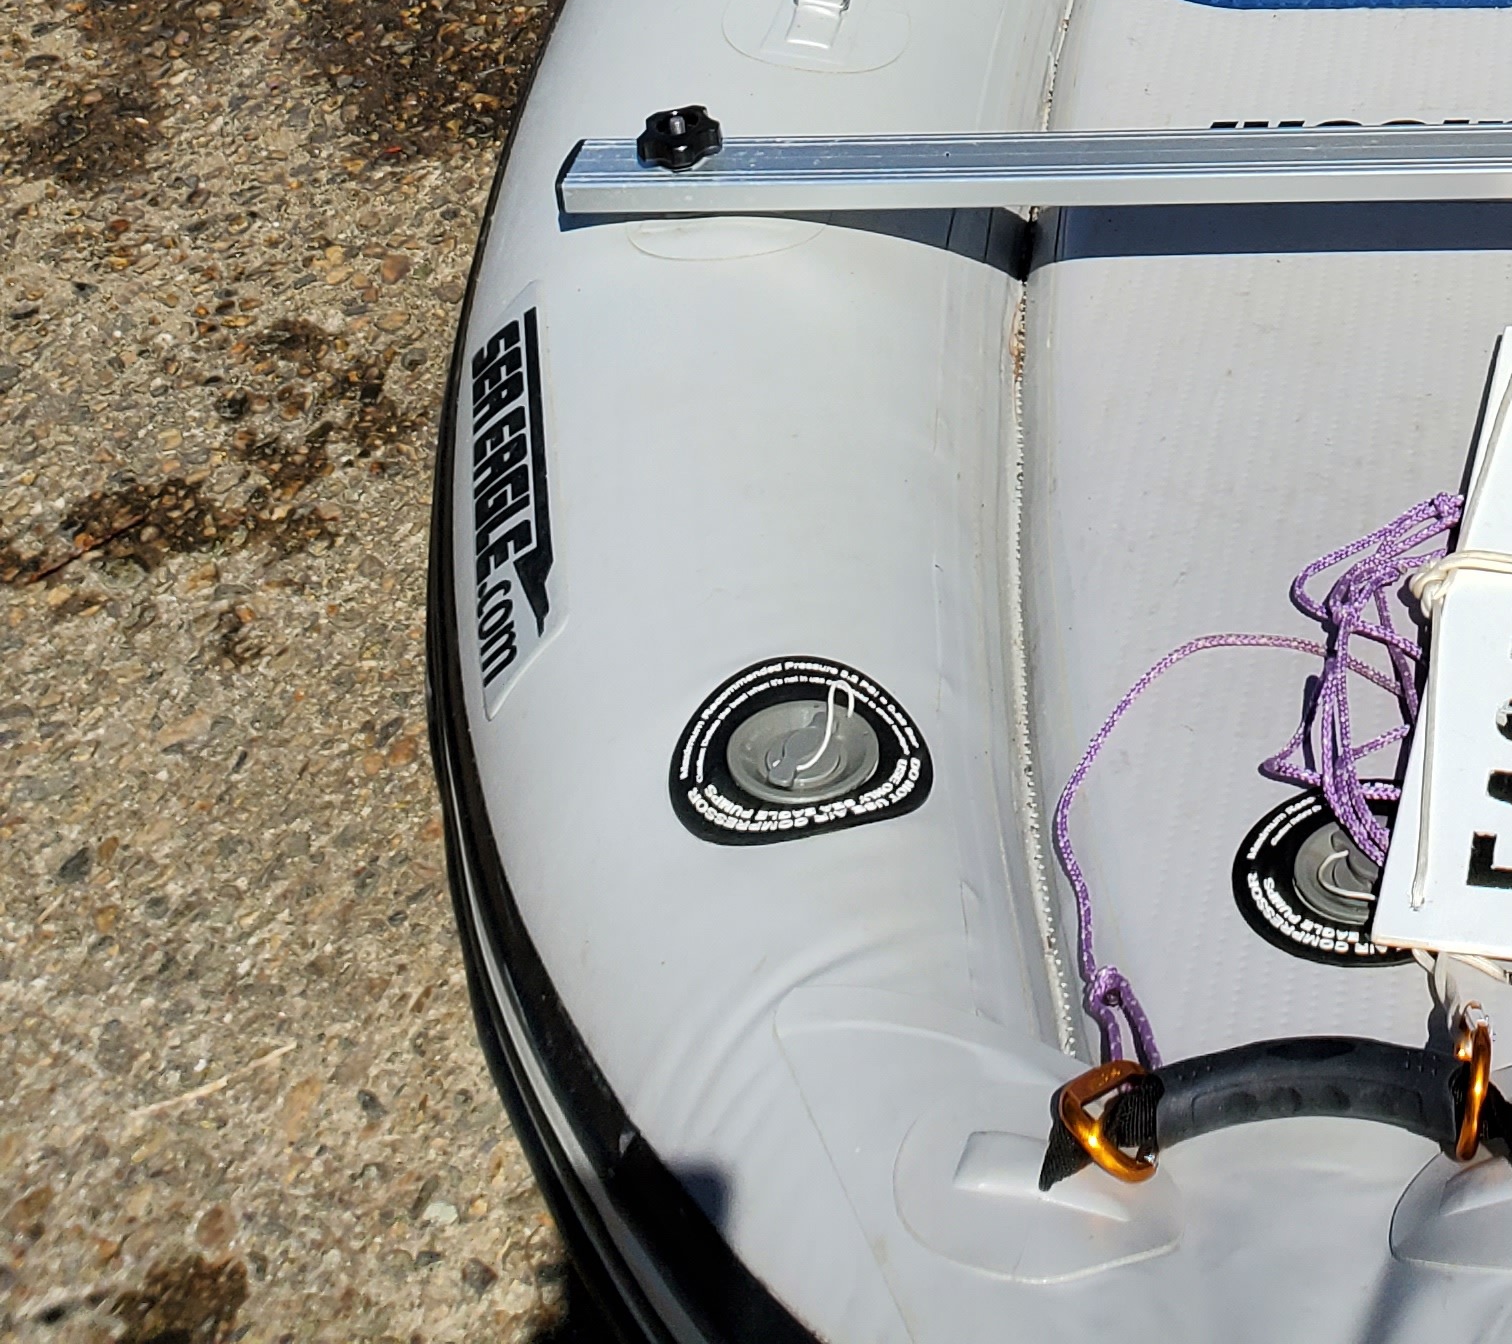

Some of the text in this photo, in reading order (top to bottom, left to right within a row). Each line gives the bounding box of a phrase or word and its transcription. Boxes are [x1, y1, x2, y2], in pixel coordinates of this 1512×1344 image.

[701, 663, 783, 720] Recommended
[785, 661, 838, 675] Pressure
[688, 757, 921, 832] DO NOT USE AIR COMPRESSOR
[704, 758, 908, 821] USE ONLY SEA EAGLE PUMPS
[1246, 813, 1287, 859] Maximum
[1248, 872, 1349, 953] COMPRESSOR
[1264, 877, 1360, 943] EAGLE PUMPS
